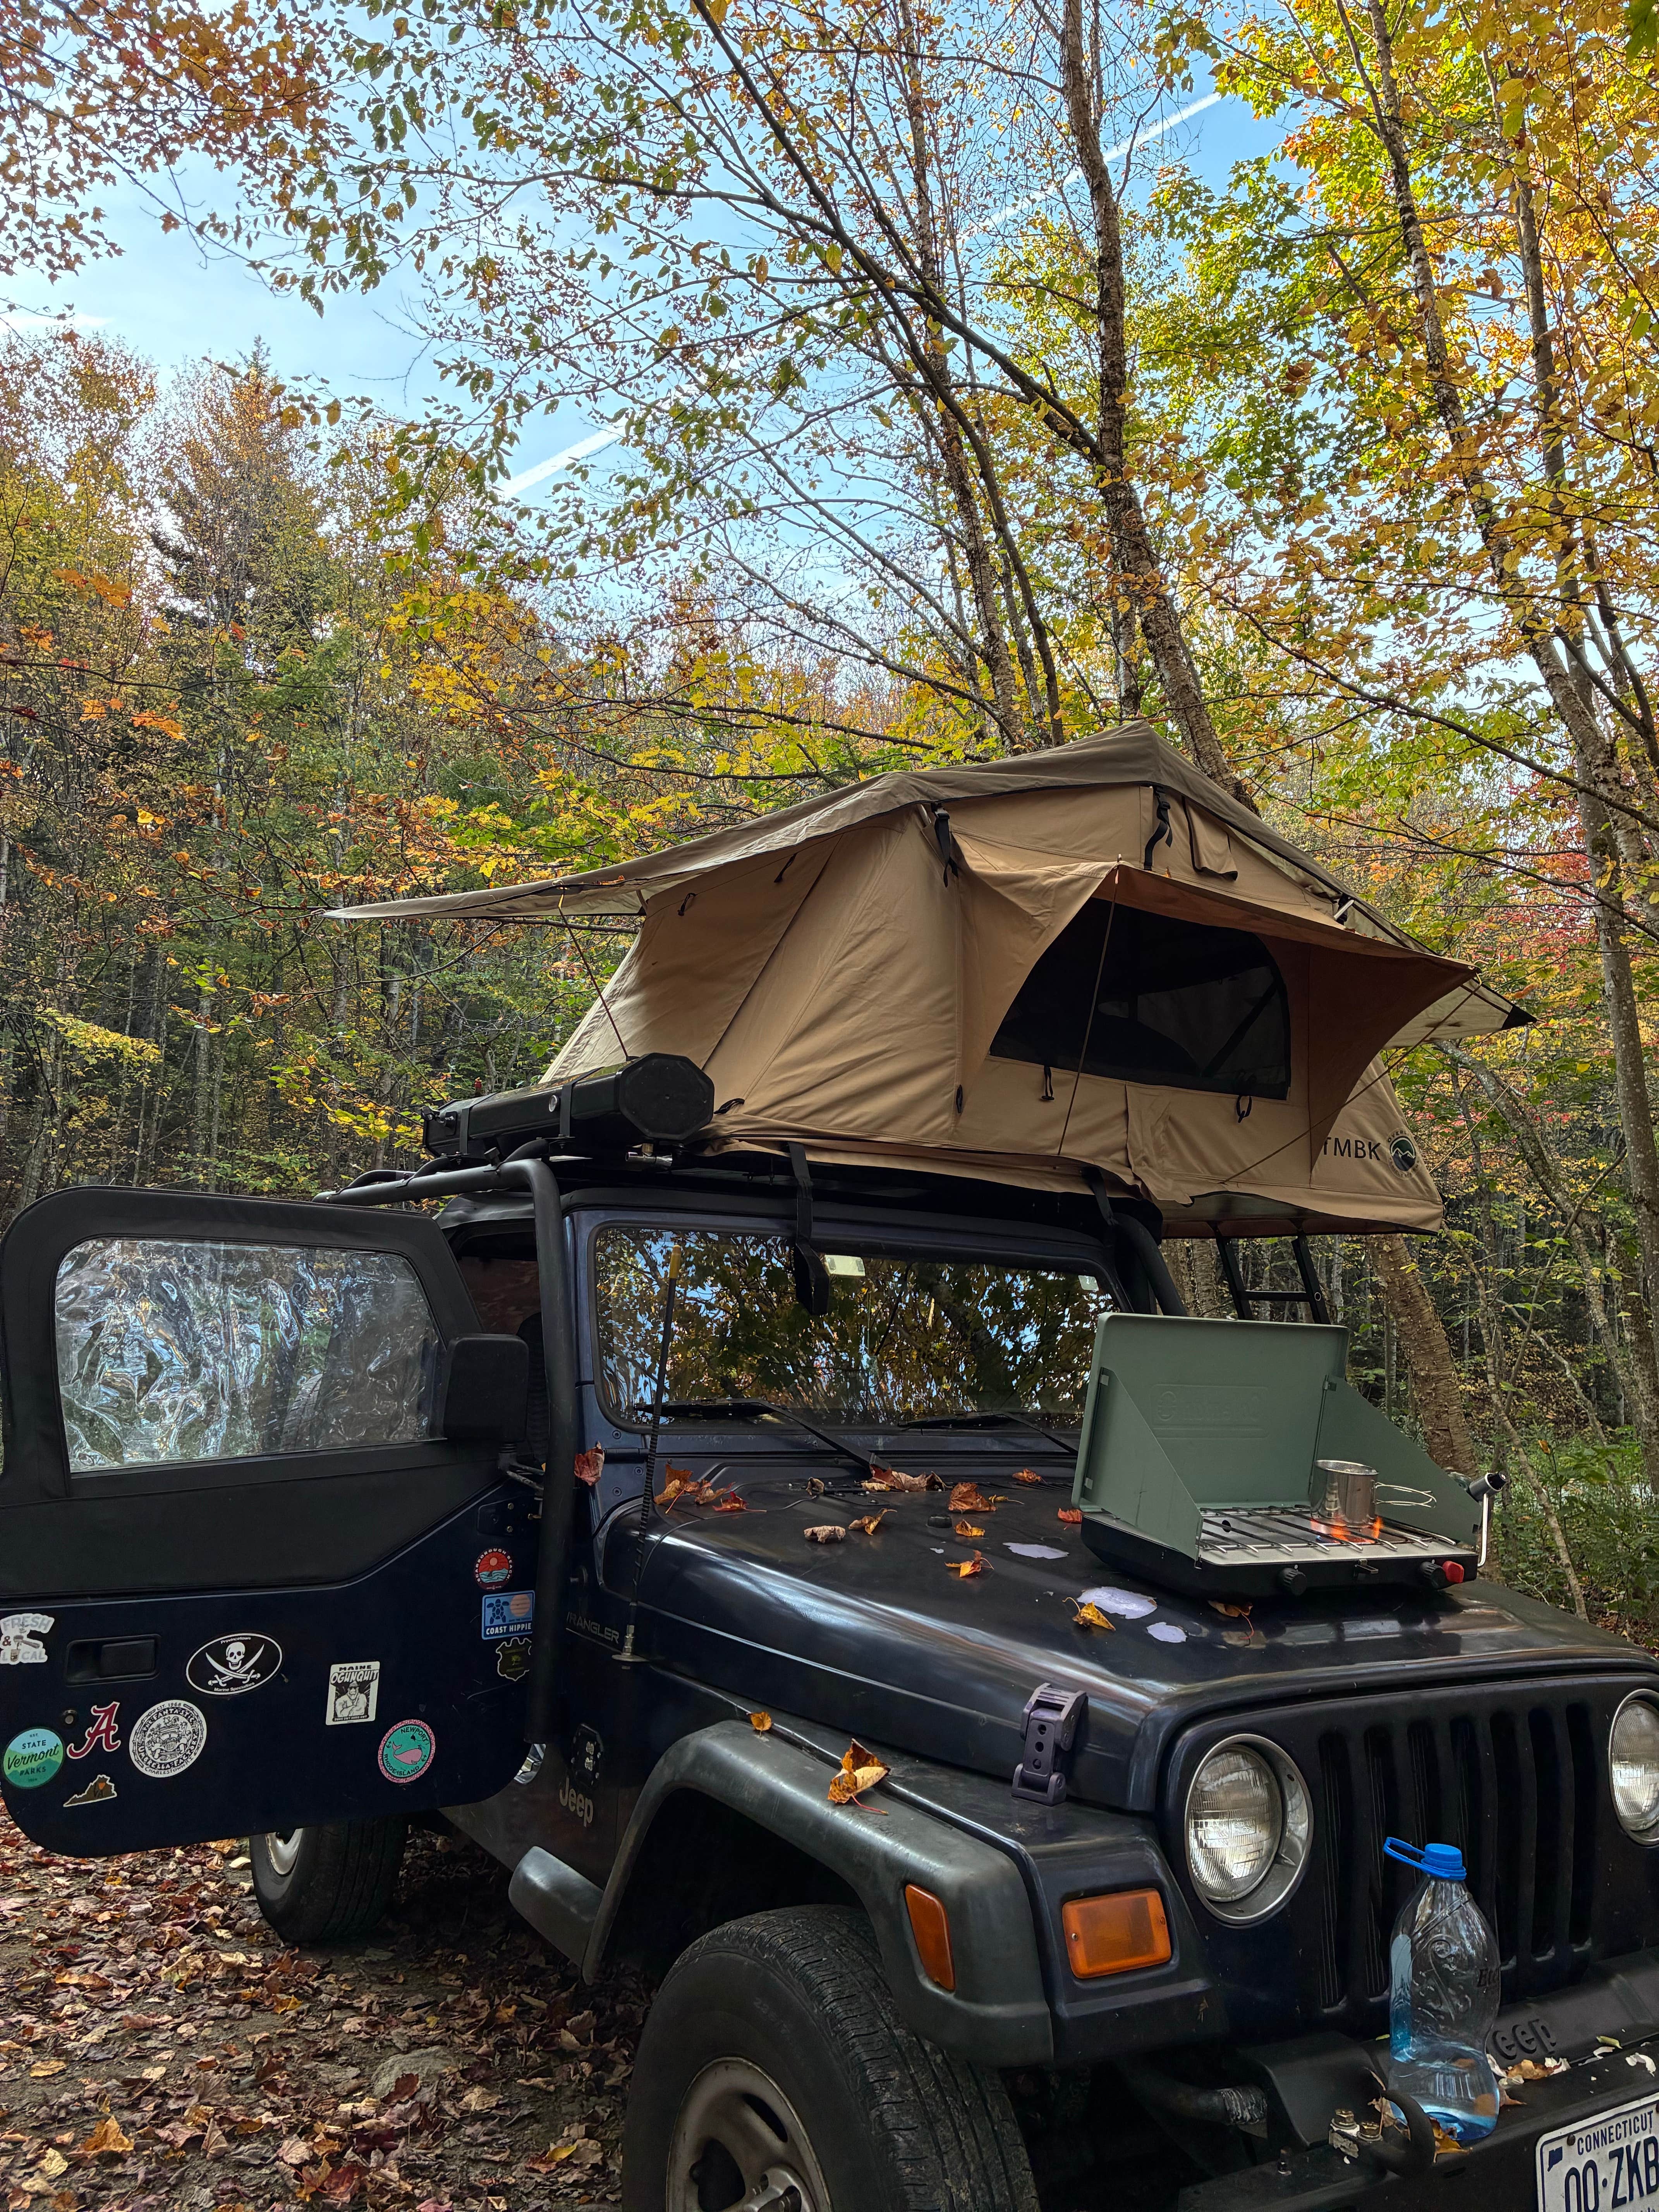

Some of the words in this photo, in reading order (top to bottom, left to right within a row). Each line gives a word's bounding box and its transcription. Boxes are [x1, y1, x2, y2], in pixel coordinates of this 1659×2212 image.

[1388, 1130, 1407, 1142] OVERL
[1324, 1137, 1381, 1161] TMBK
[475, 1548, 506, 1582] SCARBOROUGH
[3, 1616, 52, 1631] FRESH
[486, 1626, 507, 1635] COAST
[509, 1623, 531, 1632] HIPPIE
[567, 1612, 619, 1644] RANGLER
[331, 1670, 379, 1684] OGUNQUIT
[22, 1740, 46, 1749] STATE
[401, 1727, 429, 1742] NEWPORT
[8, 1743, 59, 1770] Vermont
[138, 1746, 170, 1769] UMBRELLA
[174, 1734, 198, 1767] FACTORY
[20, 1766, 46, 1776] PARKS
[384, 1754, 397, 1774] RHODE
[397, 1766, 419, 1776] ISLAND
[559, 1778, 593, 1827] Jeep
[1492, 2019, 1556, 2060] eep
[1577, 2110, 1654, 2155] CONNECTICUT
